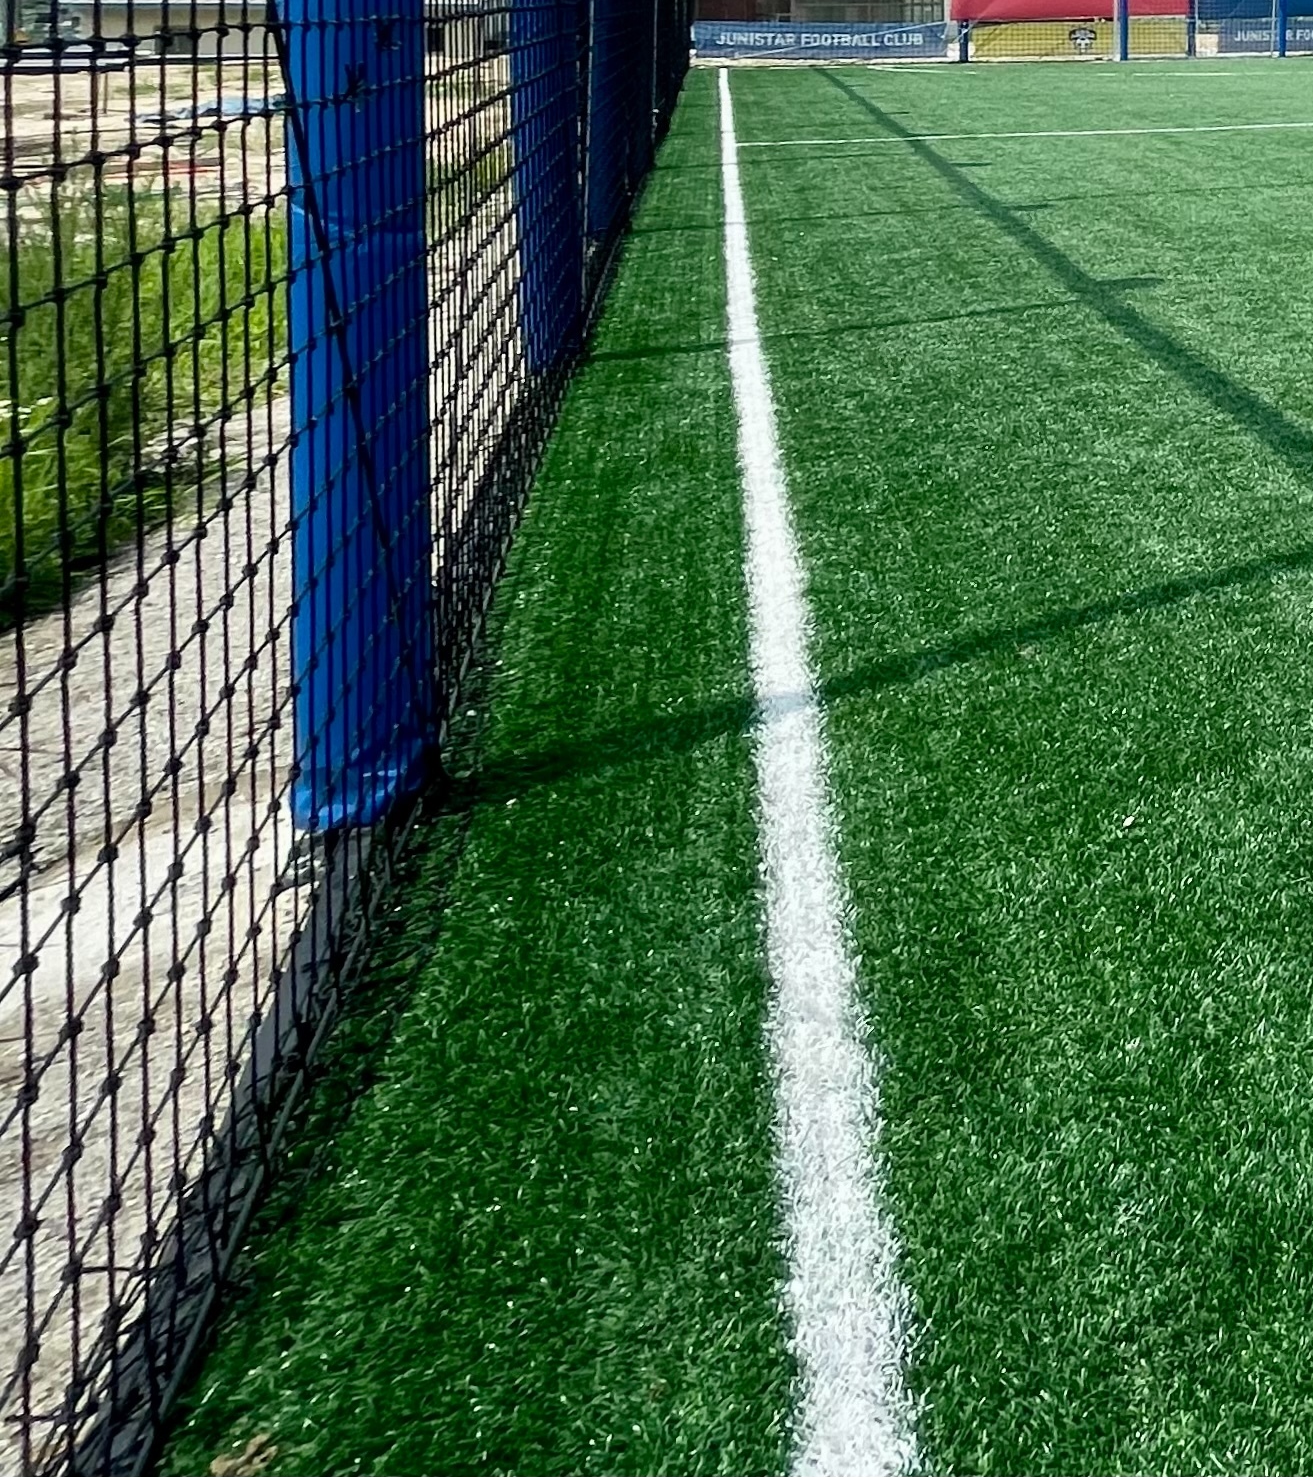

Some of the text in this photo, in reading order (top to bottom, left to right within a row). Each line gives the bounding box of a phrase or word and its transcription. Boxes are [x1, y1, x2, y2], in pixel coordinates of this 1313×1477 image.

[716, 33, 924, 47] JUNISTAR FOOTBALL CLUB
[1234, 29, 1293, 42] JUNISTR
